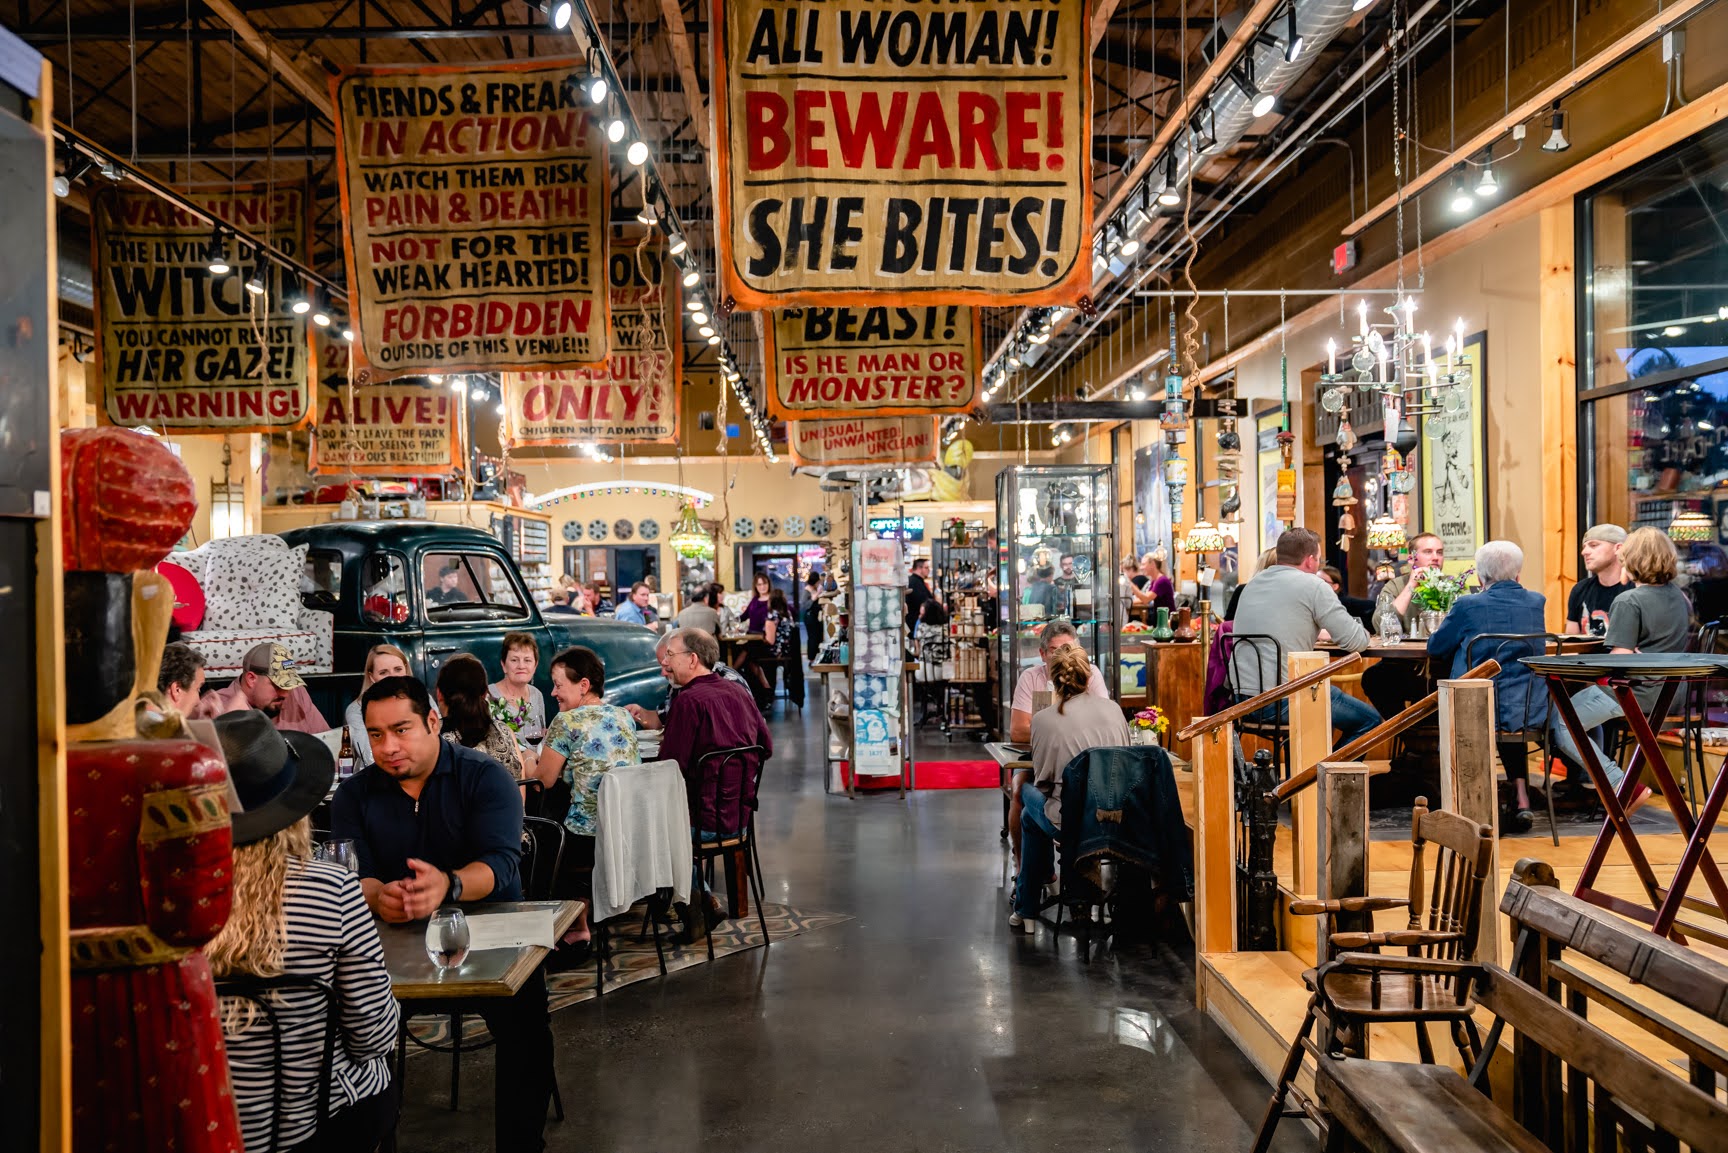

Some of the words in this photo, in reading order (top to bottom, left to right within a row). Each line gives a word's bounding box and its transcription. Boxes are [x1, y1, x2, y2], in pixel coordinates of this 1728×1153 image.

[746, 9, 823, 66] ALL
[839, 10, 1059, 67] WOMAN!
[352, 84, 453, 117] FIENDS
[460, 83, 481, 114] &
[487, 81, 577, 114] FREAK
[359, 120, 408, 158] IN
[418, 114, 592, 156] ACTION!
[745, 90, 1064, 172] BEWARE!
[364, 169, 448, 192] WATCH
[456, 167, 525, 188] THEM
[534, 164, 588, 185] RISK
[365, 194, 440, 228] PAIN
[448, 192, 472, 224] &
[479, 188, 588, 223] DEATH!
[107, 239, 148, 263] THE
[239, 237, 296, 261] DD
[370, 238, 441, 264] NOT
[451, 235, 517, 259] FOR
[528, 232, 590, 255] THE
[744, 196, 864, 277] SHE
[876, 196, 1066, 276] BITES!
[373, 263, 451, 295] WEAK
[460, 258, 589, 288] HEARTED!
[610, 251, 667, 287] OLY
[610, 288, 628, 304] HE
[382, 299, 592, 344] FORBIDDEN
[804, 306, 958, 341] BEAST!
[113, 329, 153, 347] YOU
[157, 327, 233, 346] CANNOT
[380, 341, 444, 362] OUTSIDE
[448, 340, 470, 357] OF
[473, 338, 508, 356] THIS
[515, 336, 589, 356] VENUE!!!
[117, 349, 185, 383] HER
[195, 347, 296, 381] GAZE!
[786, 356, 808, 375] IS
[817, 355, 848, 374] HE
[857, 352, 920, 372] MAN
[929, 352, 965, 371] OR
[523, 385, 661, 421] ONLY!
[787, 375, 965, 402] MONSTER?
[115, 390, 300, 420] WARNING!
[322, 396, 447, 425] ALIVE!
[322, 430, 335, 440] DO
[341, 430, 360, 439] NT
[364, 430, 393, 439] LEAVE
[398, 430, 415, 438] THE
[418, 429, 445, 438] PARK
[519, 426, 575, 435] CHILDREN
[579, 426, 604, 435] NOT
[607, 426, 668, 435] ADMITTED
[800, 420, 864, 443] UNUSUAL!
[824, 426, 901, 450] UNWANTED!
[867, 434, 928, 455] UNCLEAN!
[380, 441, 416, 450] SEEING
